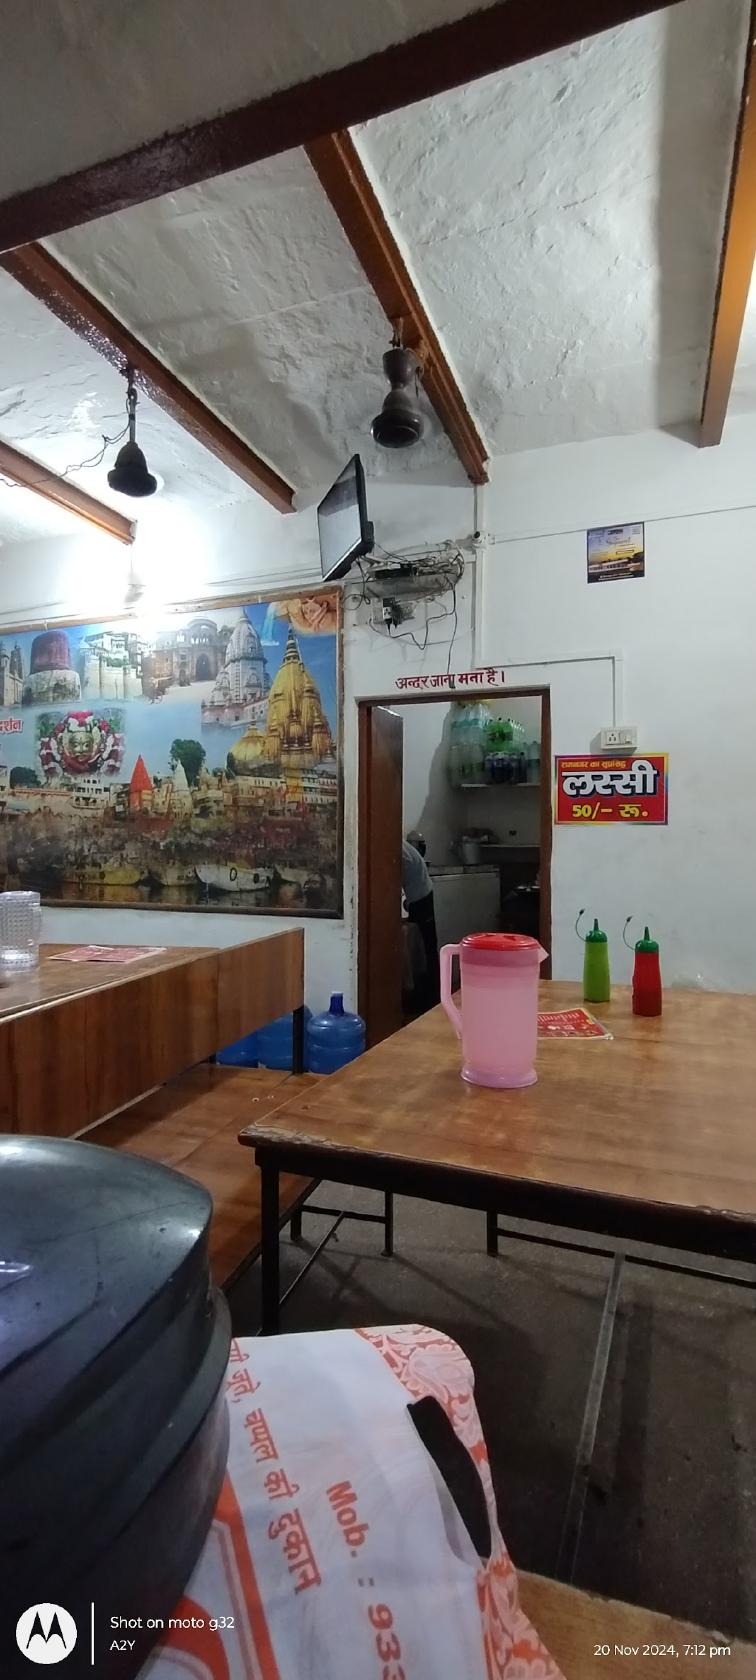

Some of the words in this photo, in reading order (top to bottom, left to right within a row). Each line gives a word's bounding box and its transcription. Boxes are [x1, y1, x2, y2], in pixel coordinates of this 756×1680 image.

[457, 671, 484, 685] मना
[562, 760, 659, 797] लस्सी
[572, 802, 613, 819] 50/-
[326, 1481, 369, 1558] Mob.
[268, 1508, 321, 1595] दुकान
